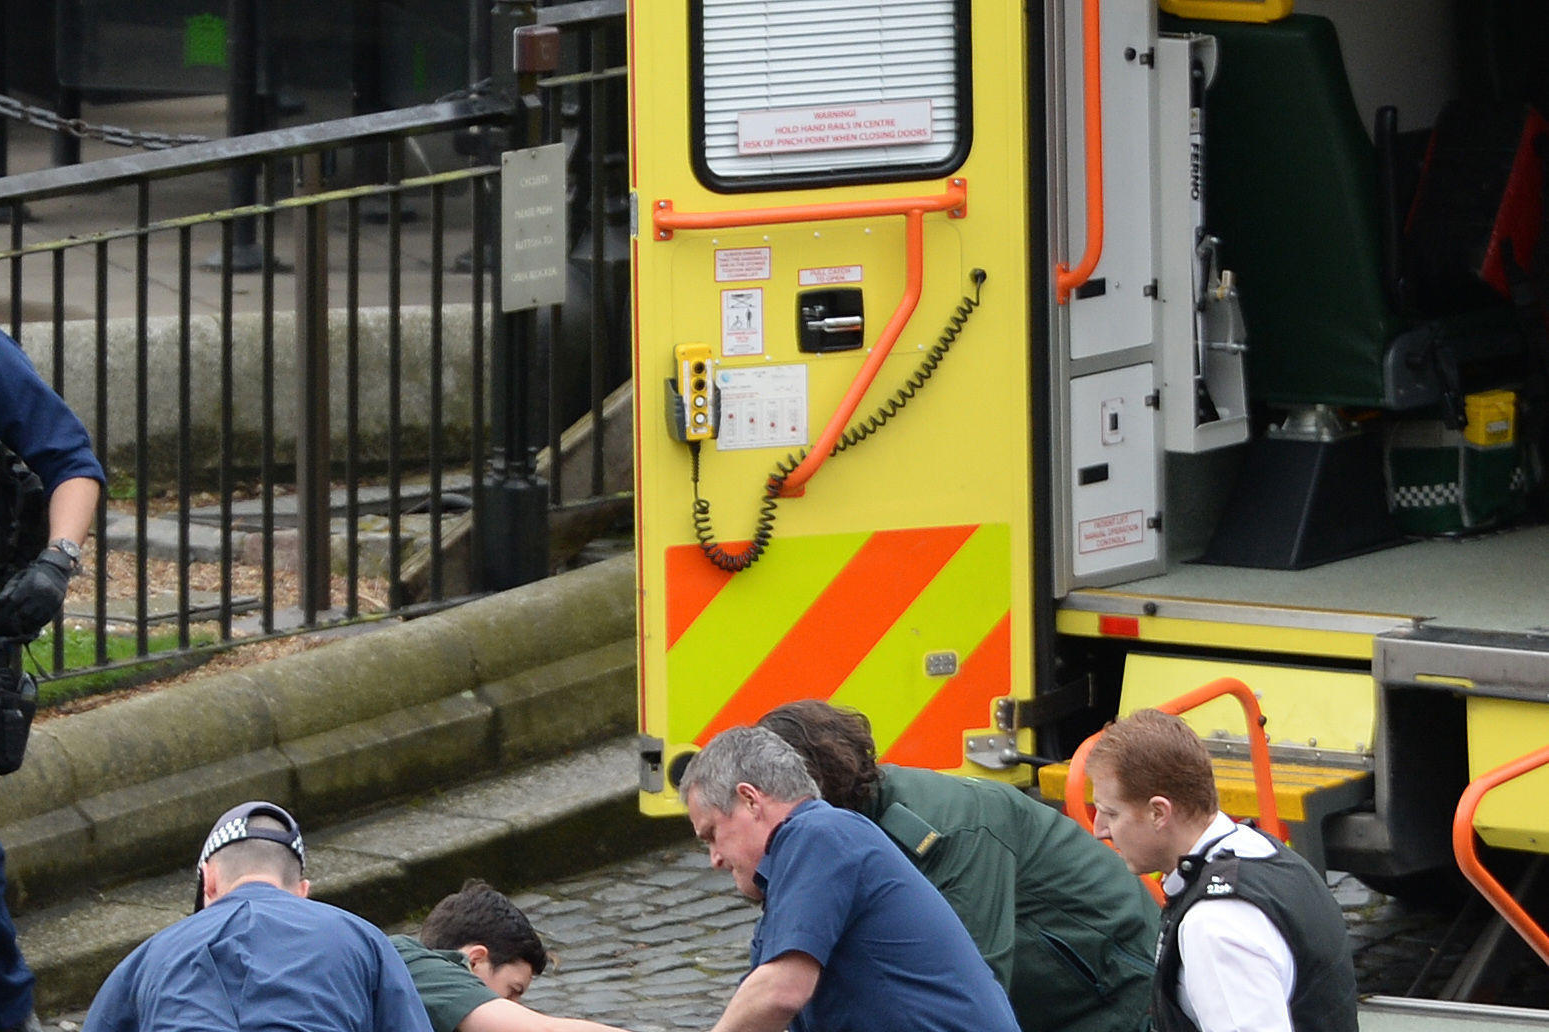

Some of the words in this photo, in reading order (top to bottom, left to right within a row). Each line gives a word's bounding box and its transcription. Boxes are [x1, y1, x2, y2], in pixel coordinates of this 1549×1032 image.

[813, 109, 856, 120] WARNING!
[775, 126, 799, 135] HOLD
[801, 124, 826, 133] HAND
[827, 122, 851, 131] RAILS
[852, 121, 862, 129] IN
[863, 118, 896, 128] CENTRE
[743, 140, 762, 149] RISK
[763, 139, 775, 147] OF
[777, 137, 803, 146] PINCH
[804, 135, 830, 145] POINT
[831, 134, 858, 143] WHEN
[859, 131, 896, 141] CLOSING
[897, 128, 928, 138] DOORS
